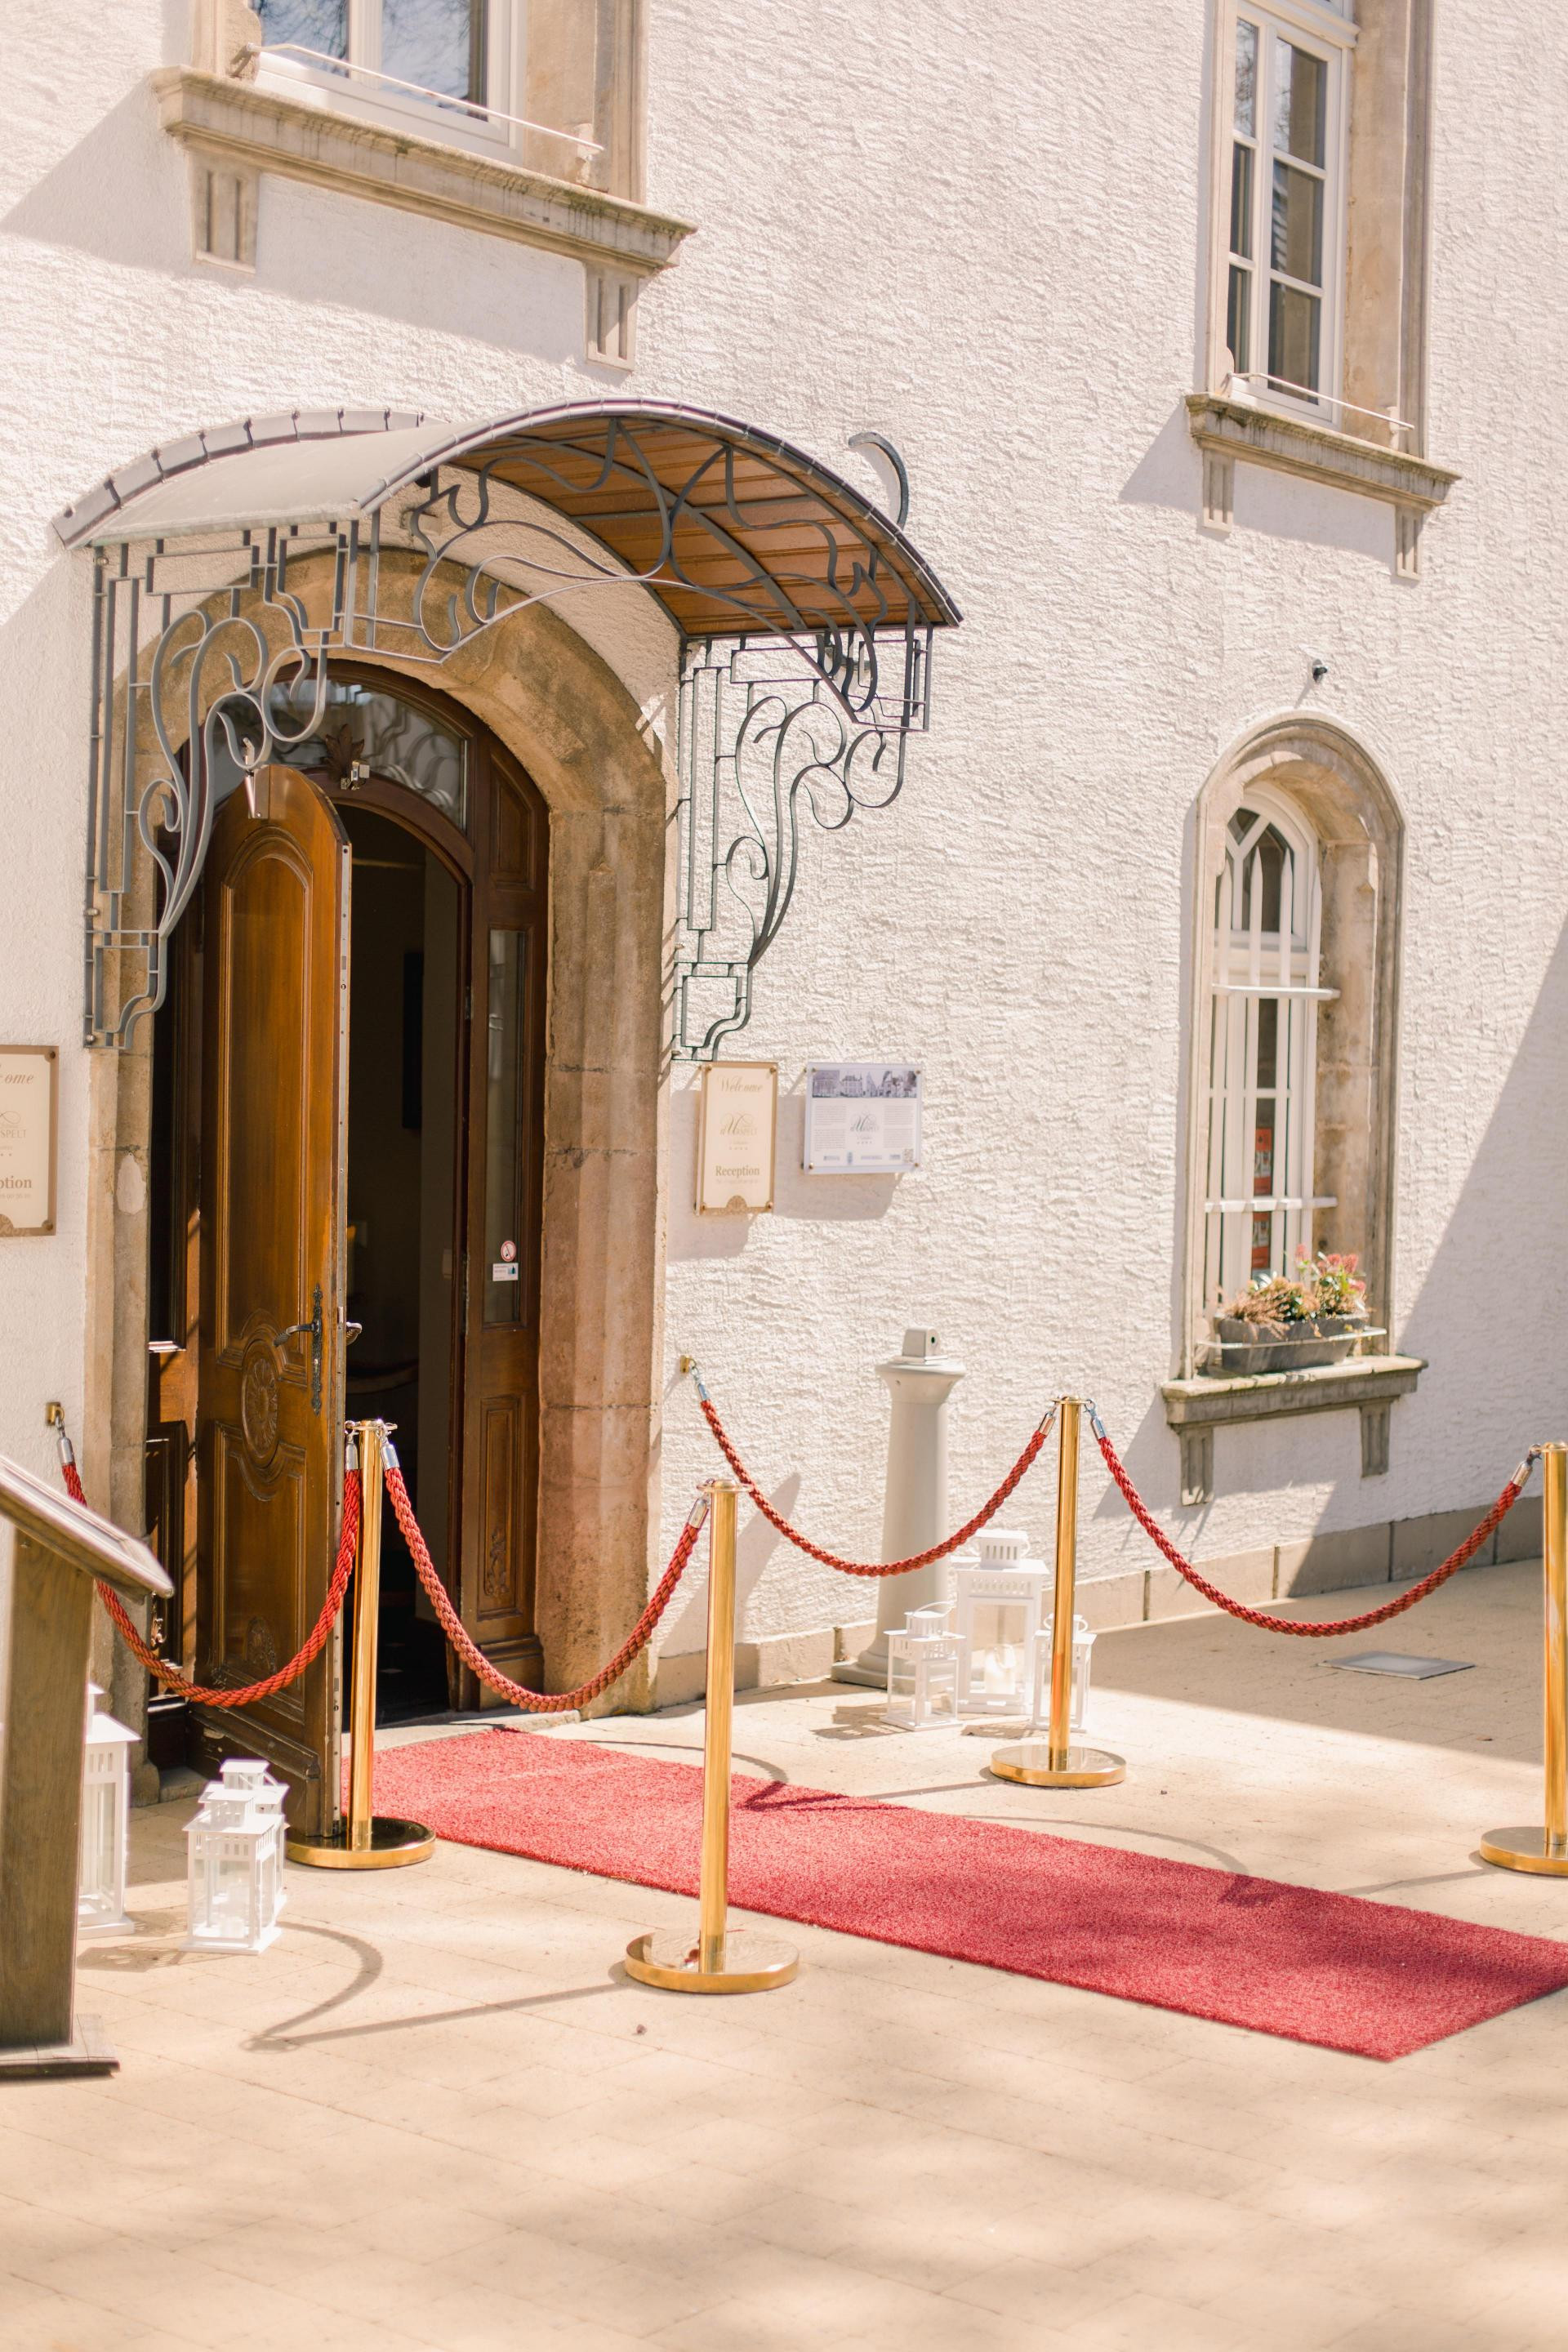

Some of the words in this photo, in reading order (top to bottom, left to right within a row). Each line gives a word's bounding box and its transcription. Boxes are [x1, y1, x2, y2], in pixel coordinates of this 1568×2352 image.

[0, 1073, 34, 1084] ome
[718, 1075, 763, 1093] Welcome
[715, 1165, 760, 1178] Reception
